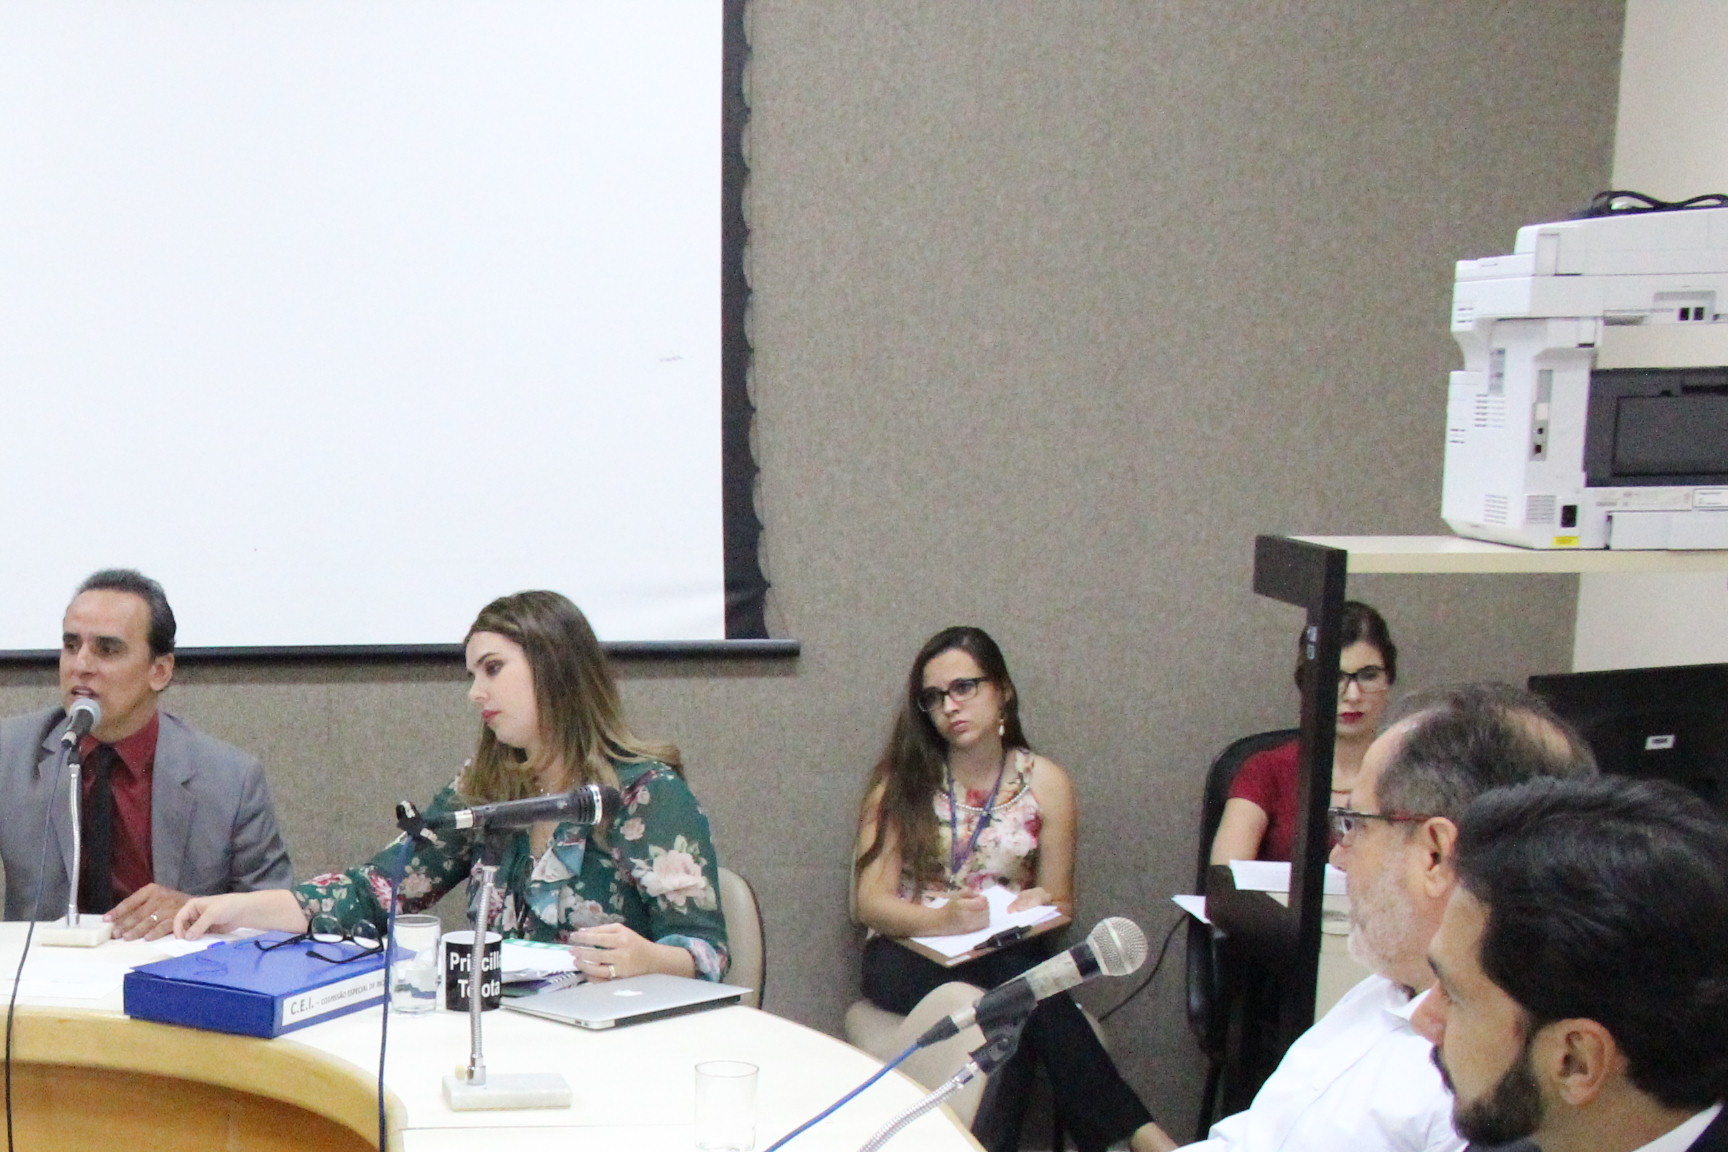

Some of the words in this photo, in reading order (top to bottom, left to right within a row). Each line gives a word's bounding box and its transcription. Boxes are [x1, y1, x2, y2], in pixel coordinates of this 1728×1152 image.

[450, 951, 500, 972] Pricill
[457, 979, 500, 998] Tota
[290, 997, 314, 1015] C.E.I.
